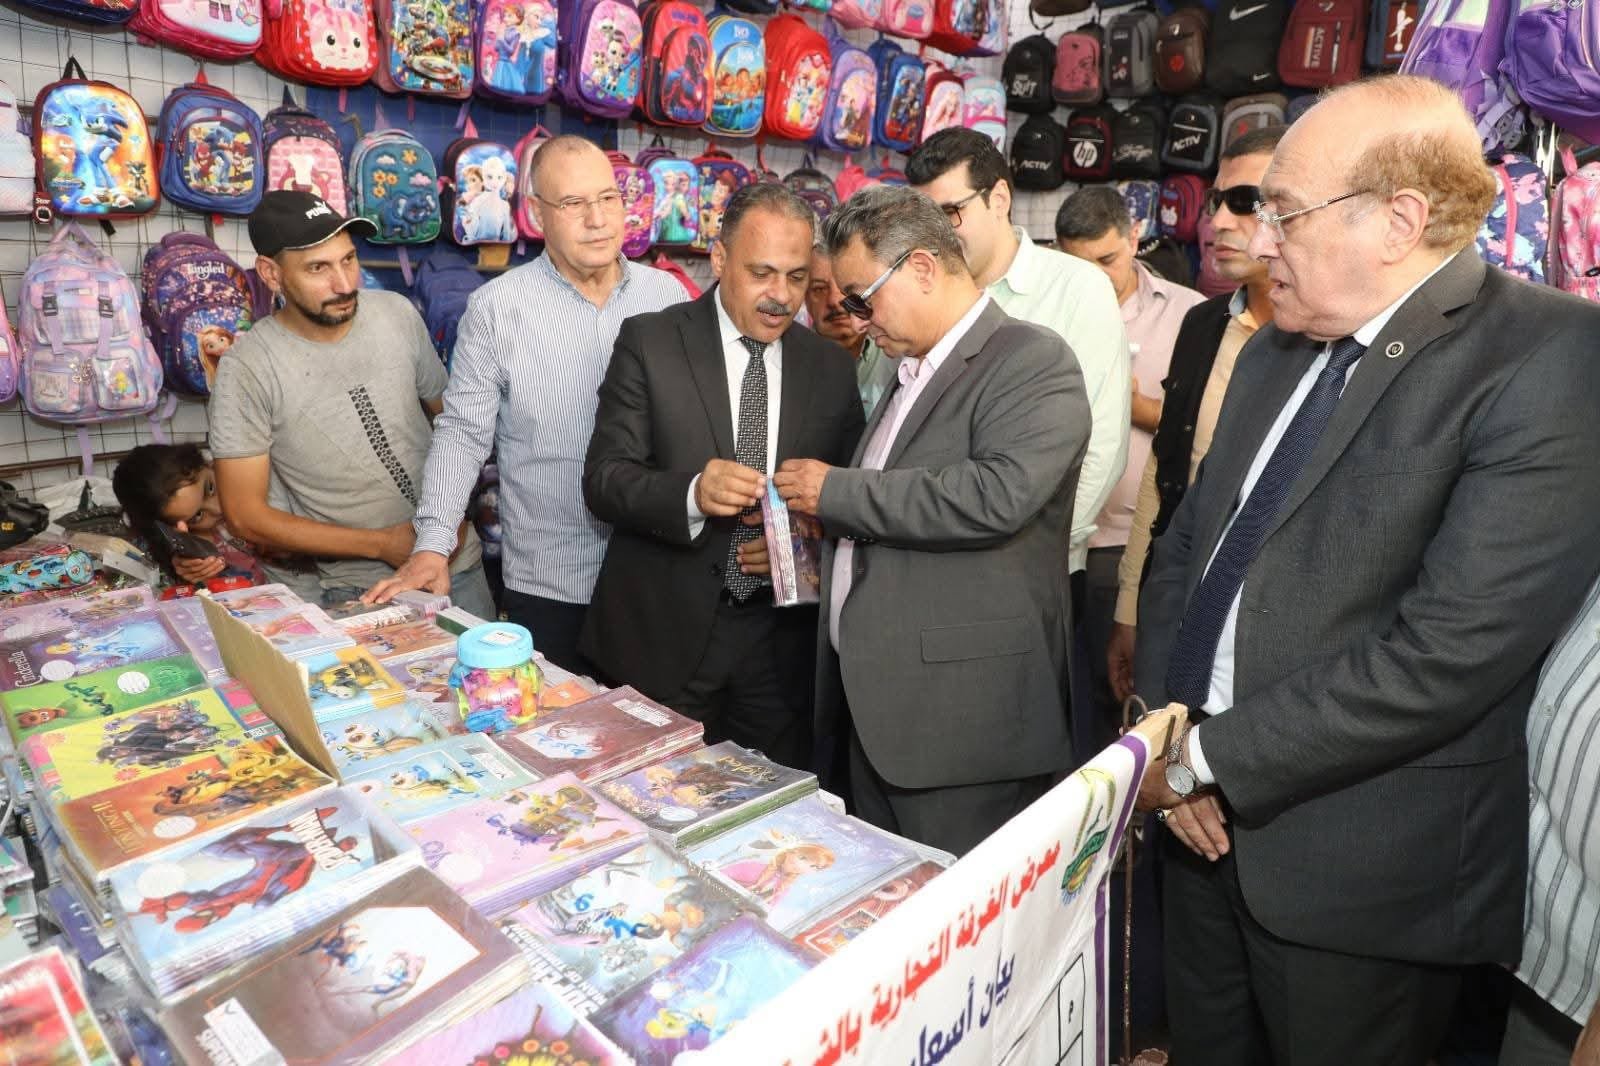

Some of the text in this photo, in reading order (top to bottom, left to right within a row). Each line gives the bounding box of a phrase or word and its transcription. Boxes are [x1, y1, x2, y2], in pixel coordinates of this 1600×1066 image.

[1310, 26, 1325, 68] ACTIVE
[1074, 140, 1097, 169] hp
[187, 261, 226, 281] Tangled
[1012, 840, 1060, 909] معرض
[956, 873, 1010, 949] الغرفة
[870, 922, 951, 1032] التجارية
[911, 950, 1015, 1066] بيان أسعا
